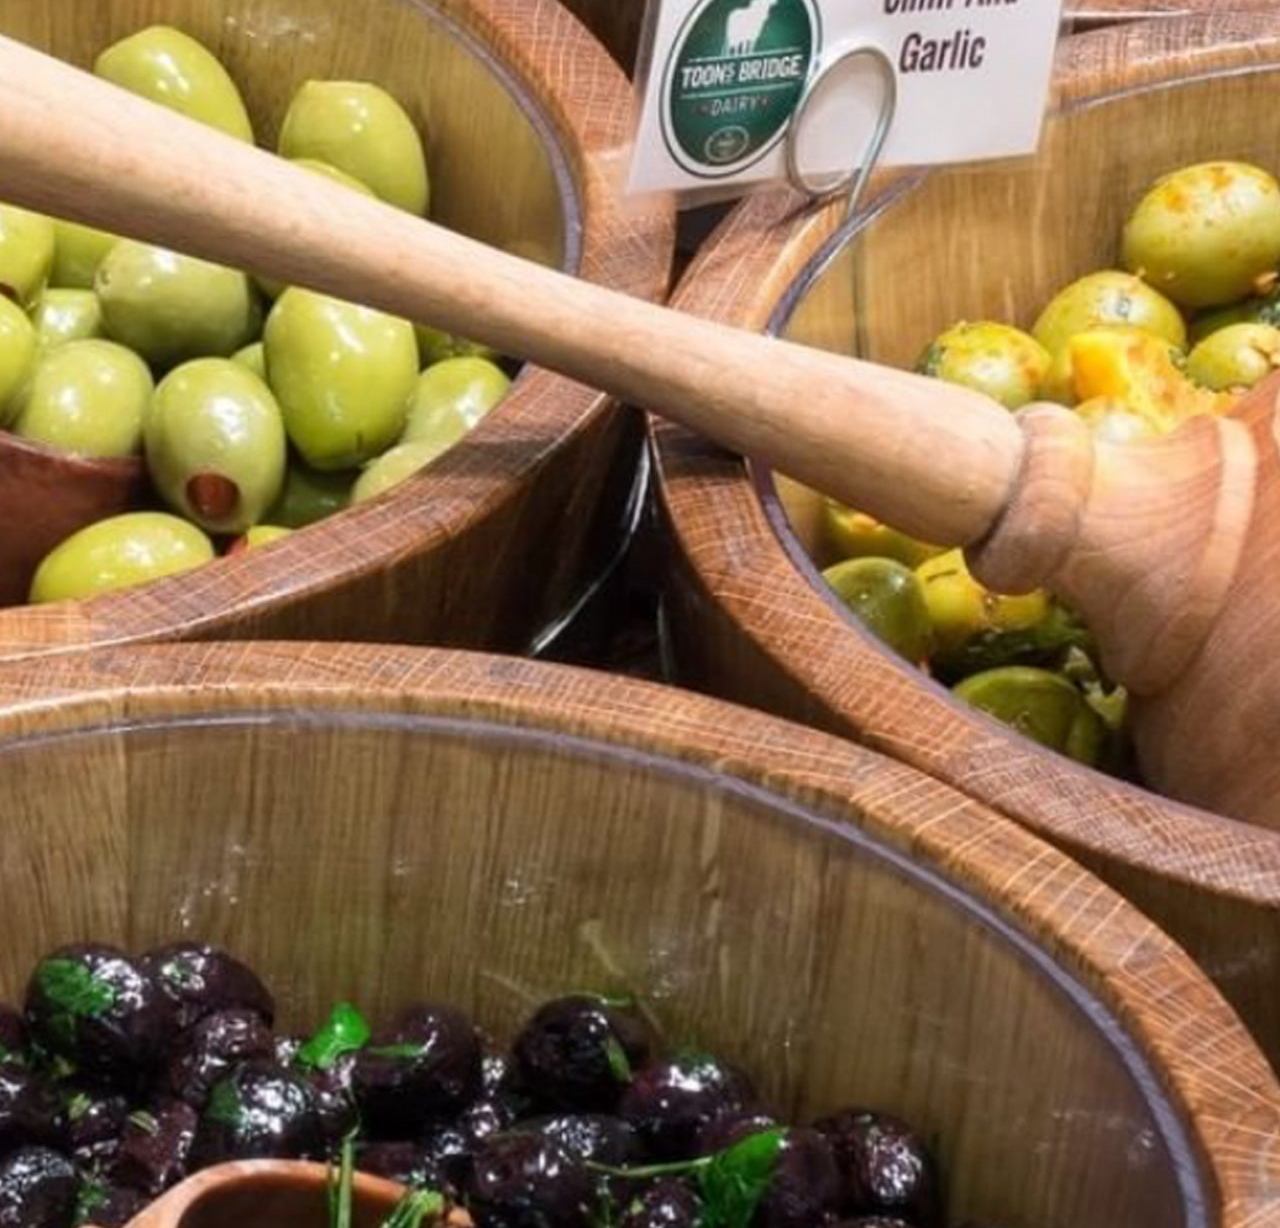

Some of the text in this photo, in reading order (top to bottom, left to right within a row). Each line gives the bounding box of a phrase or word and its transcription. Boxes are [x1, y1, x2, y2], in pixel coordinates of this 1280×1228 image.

[899, 29, 986, 74] Garlic
[738, 54, 803, 83] BRIDGE
[711, 95, 758, 117] DAIRY
